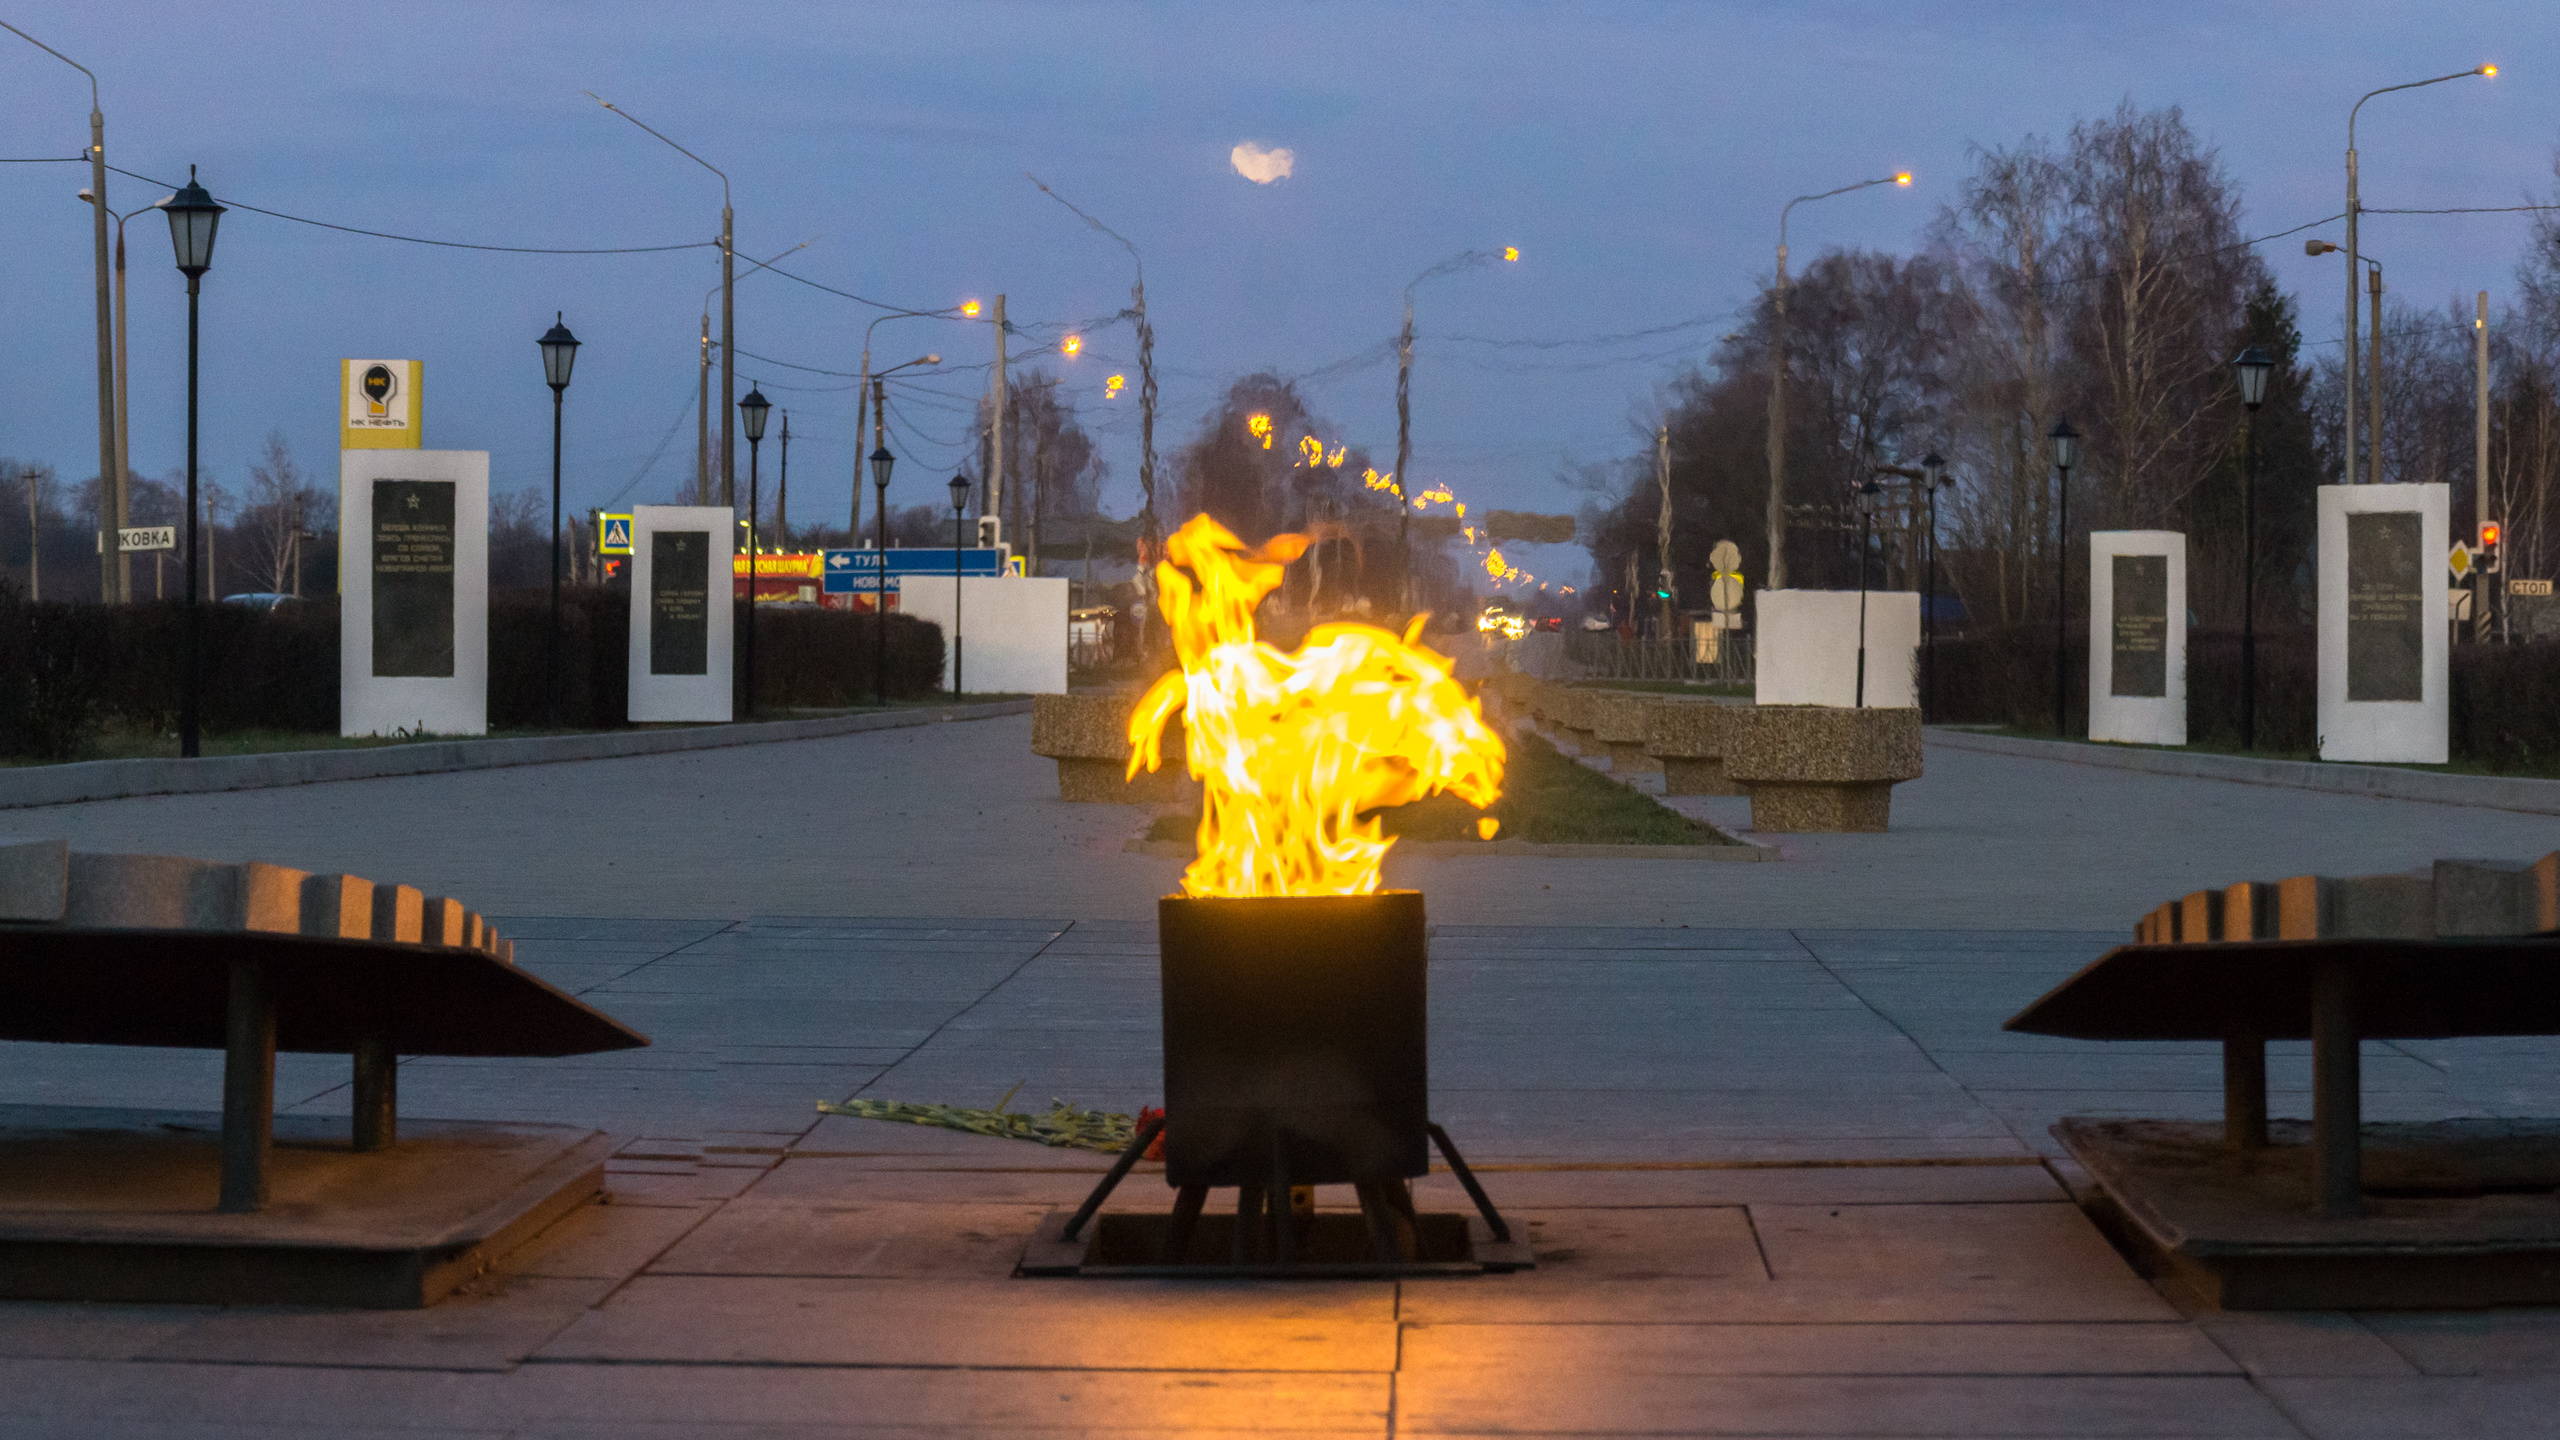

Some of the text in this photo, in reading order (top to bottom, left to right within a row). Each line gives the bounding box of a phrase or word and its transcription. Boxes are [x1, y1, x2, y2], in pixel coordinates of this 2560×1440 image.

[367, 377, 387, 387] НК
[746, 560, 777, 573] ВУСНАЯ
[854, 554, 889, 567] ТУЛА
[2512, 582, 2548, 594] СТОП
